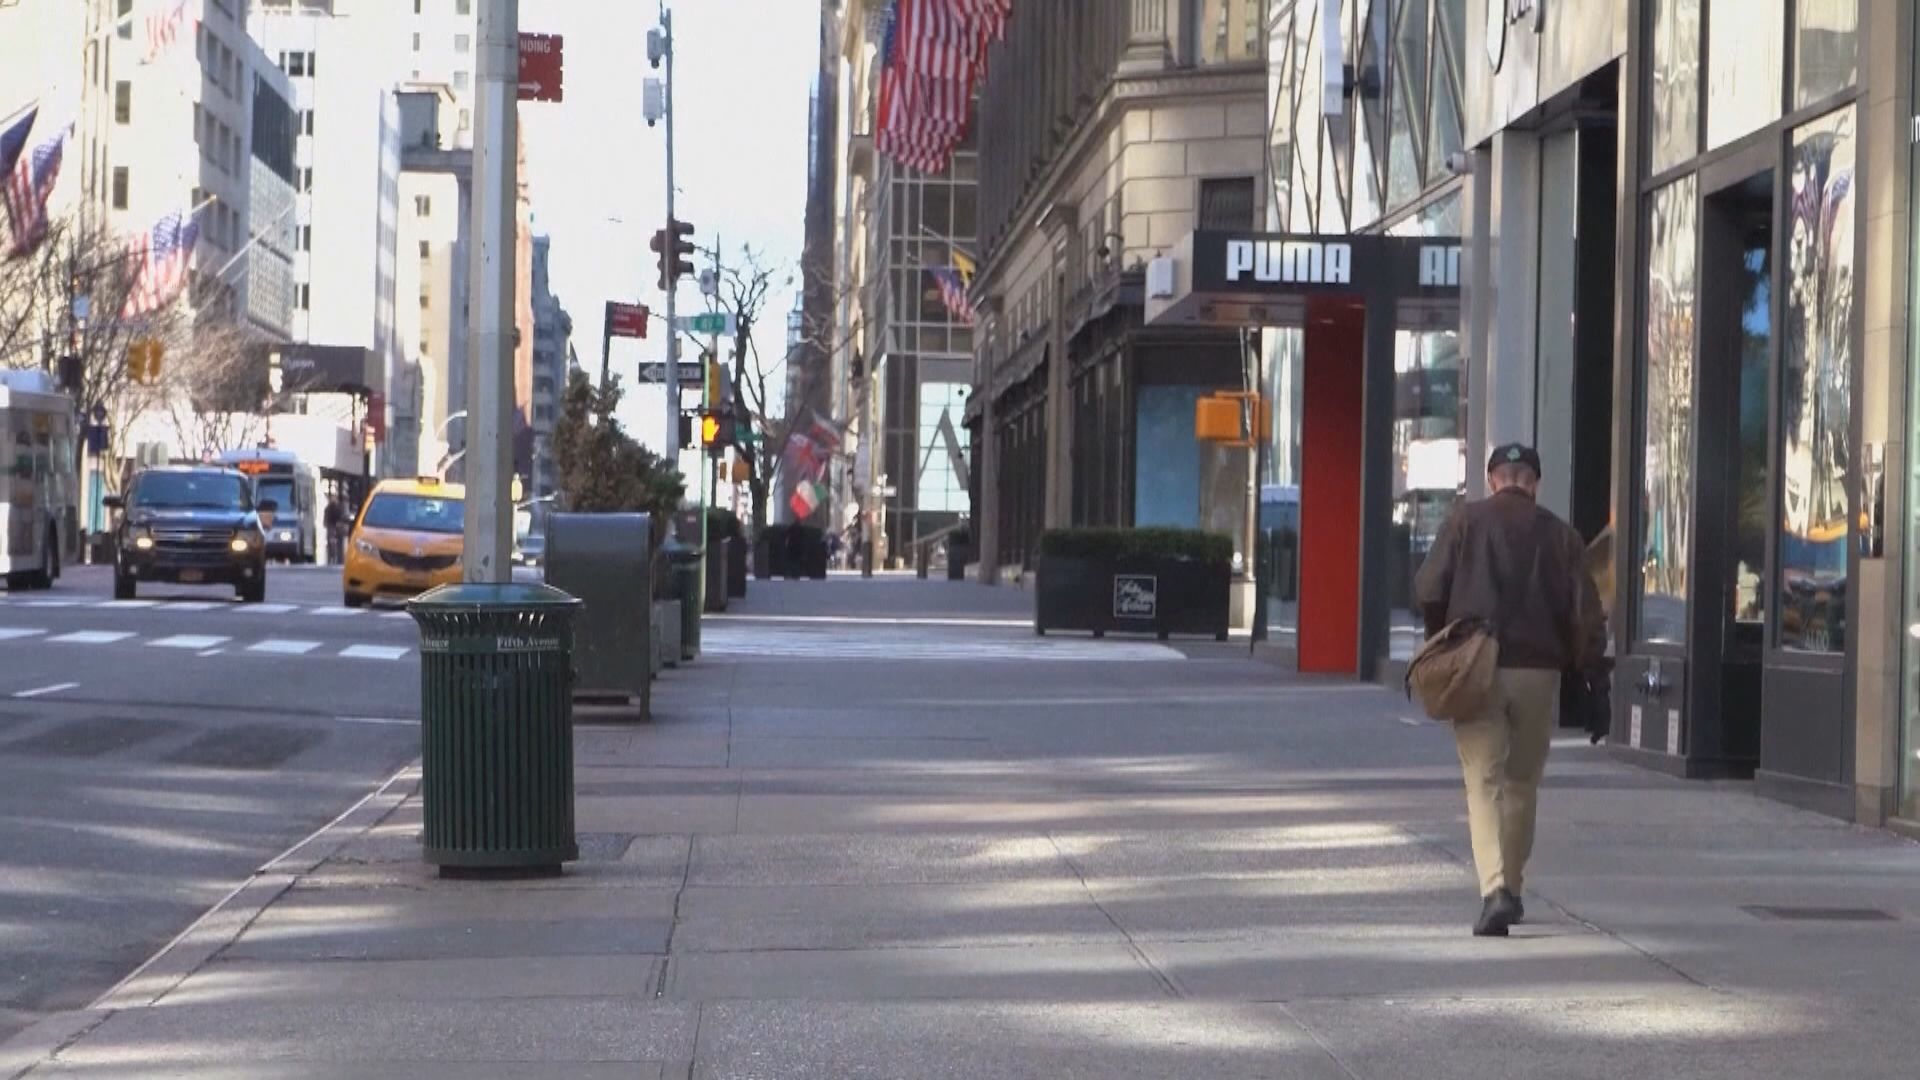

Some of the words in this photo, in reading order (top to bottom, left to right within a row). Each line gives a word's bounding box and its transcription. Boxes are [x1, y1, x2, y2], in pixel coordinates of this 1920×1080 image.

[519, 39, 551, 54] NDING
[1226, 240, 1351, 283] PUMA
[497, 636, 524, 648] Fifth
[526, 637, 559, 648] Avenue
